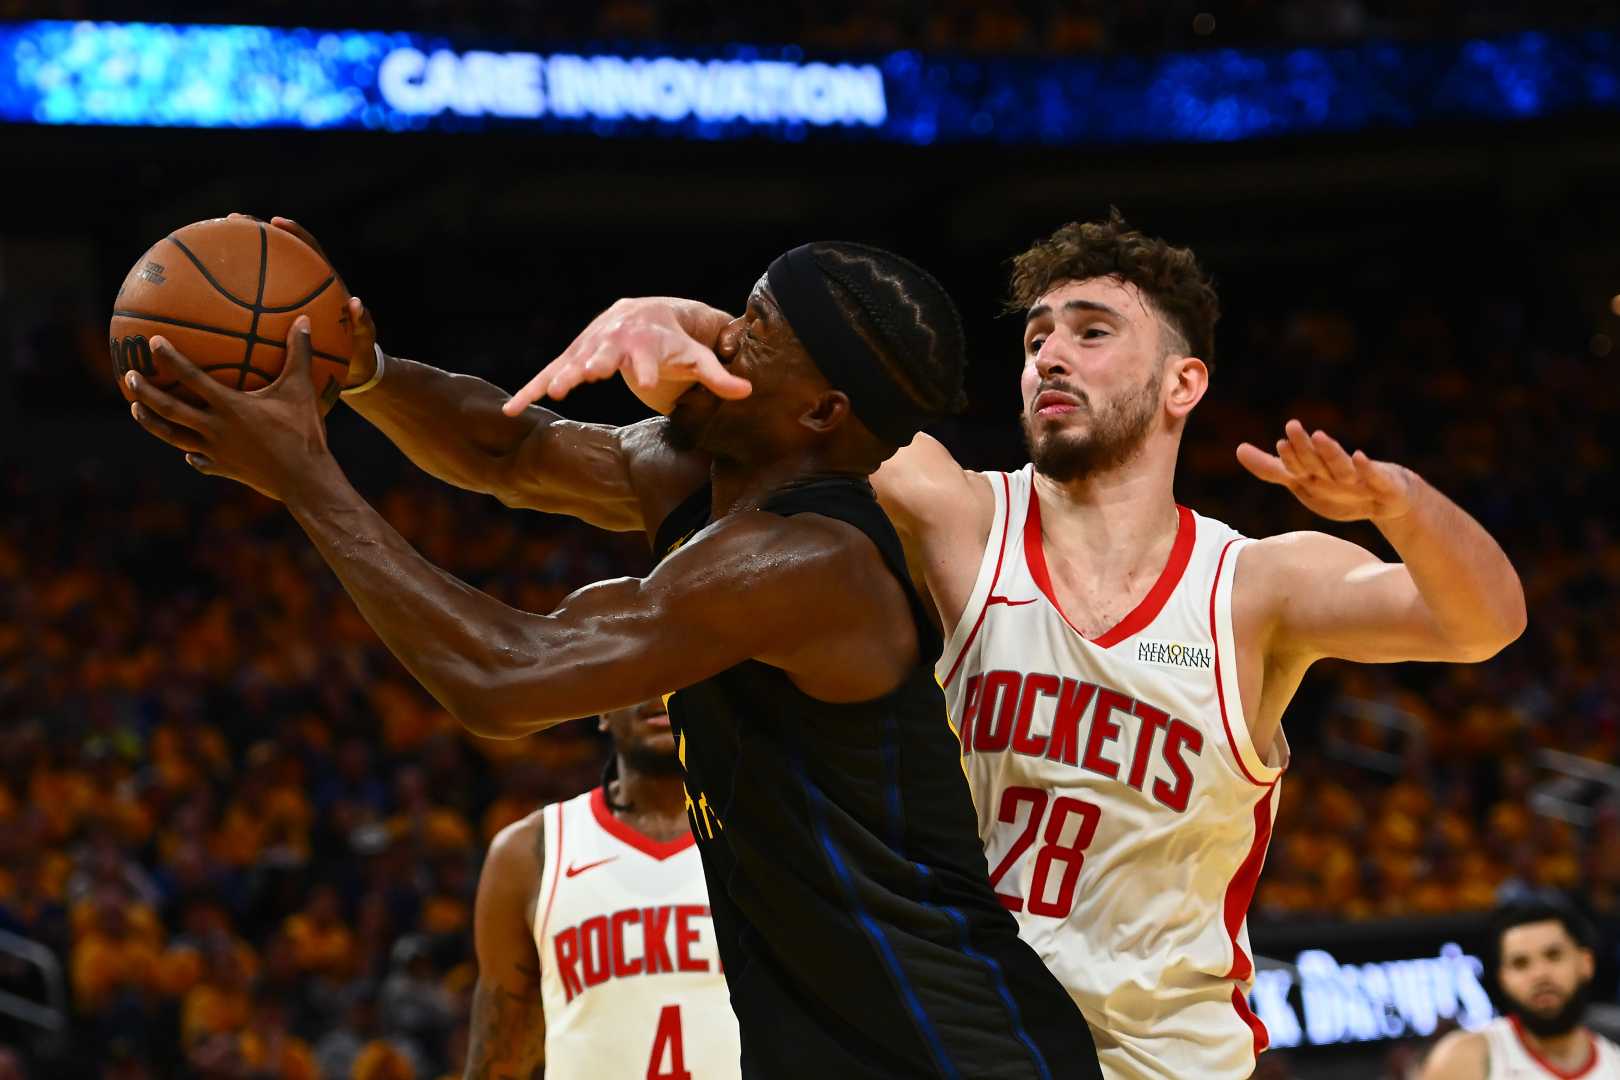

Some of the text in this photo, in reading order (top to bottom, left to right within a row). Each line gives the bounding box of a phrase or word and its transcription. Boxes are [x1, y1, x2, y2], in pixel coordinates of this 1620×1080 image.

[379, 49, 886, 126] CARE INNOVATION
[1138, 642, 1211, 659] MEMORIAL
[1138, 650, 1210, 668] HERMANN
[962, 670, 1204, 813] ROCKETS
[988, 786, 1101, 919] 28
[554, 904, 725, 1004] ROCKE
[646, 1004, 691, 1080] 4
